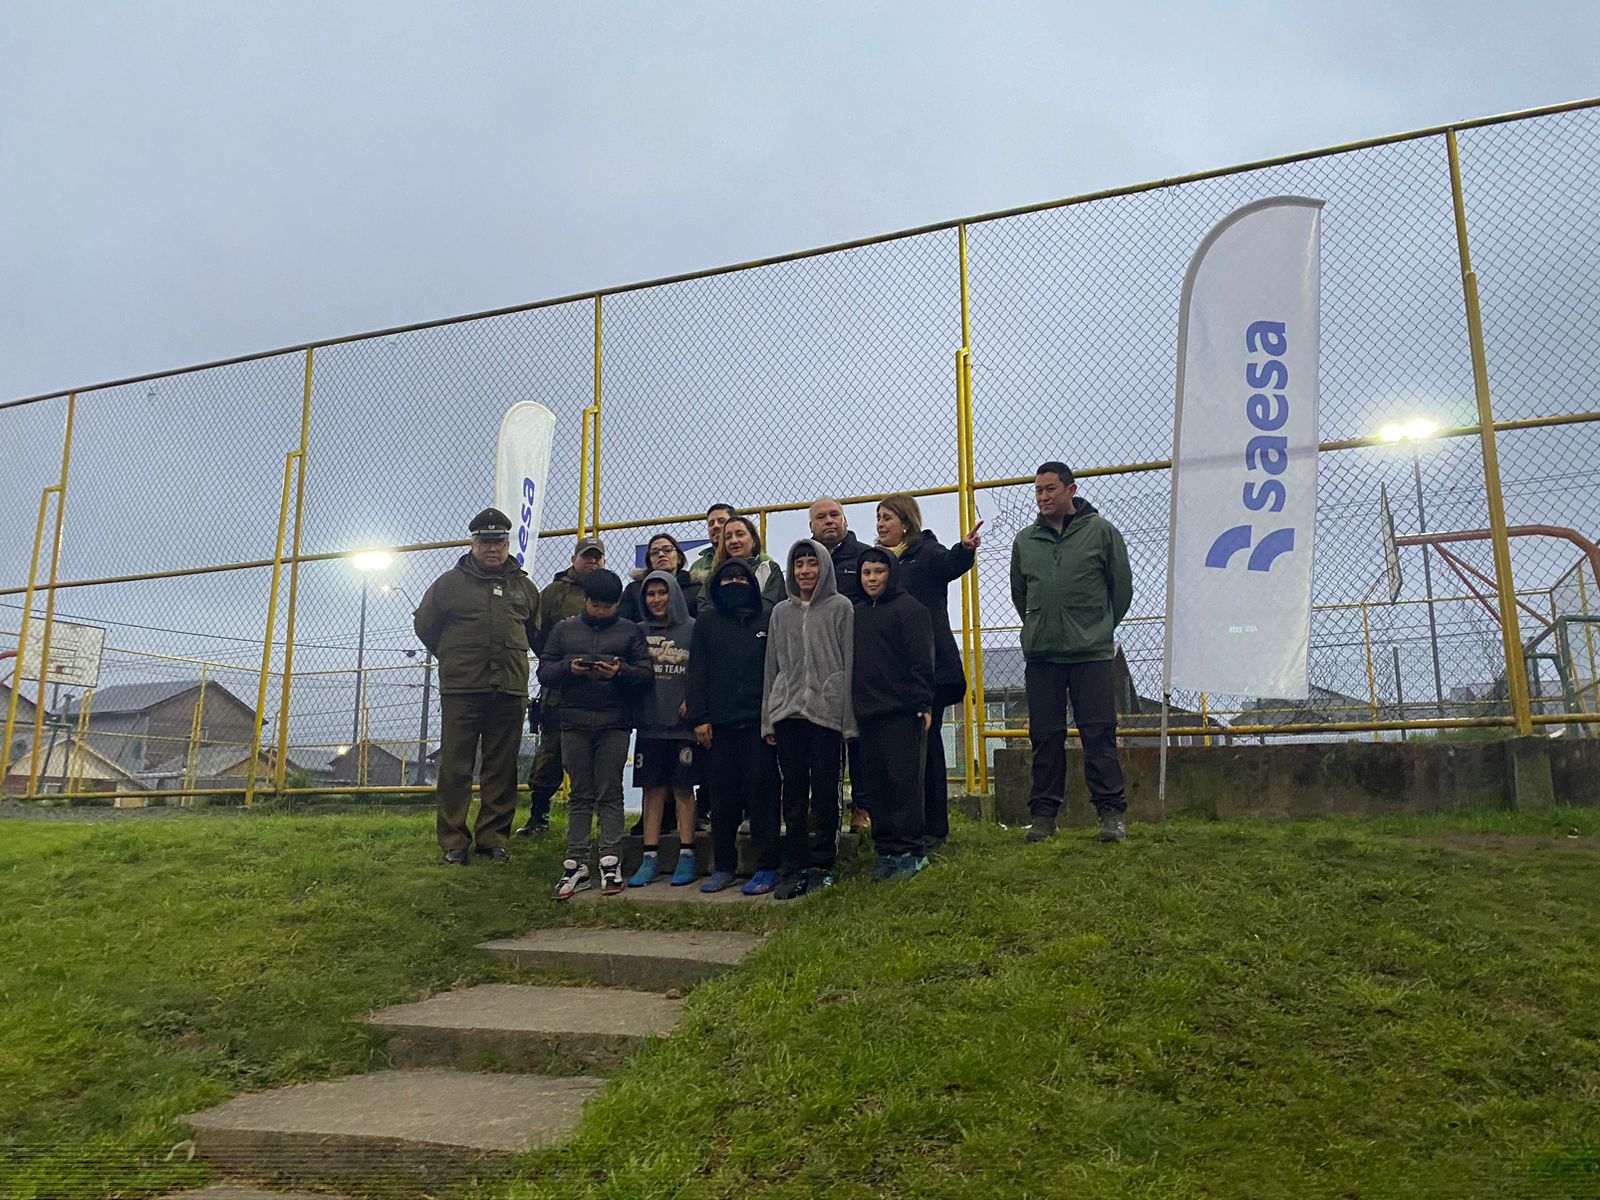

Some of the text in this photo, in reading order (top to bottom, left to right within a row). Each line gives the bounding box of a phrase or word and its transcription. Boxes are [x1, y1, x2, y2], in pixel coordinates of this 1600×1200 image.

[1242, 320, 1289, 513] saesa
[516, 477, 535, 567] esa
[664, 664, 686, 674] TEAM
